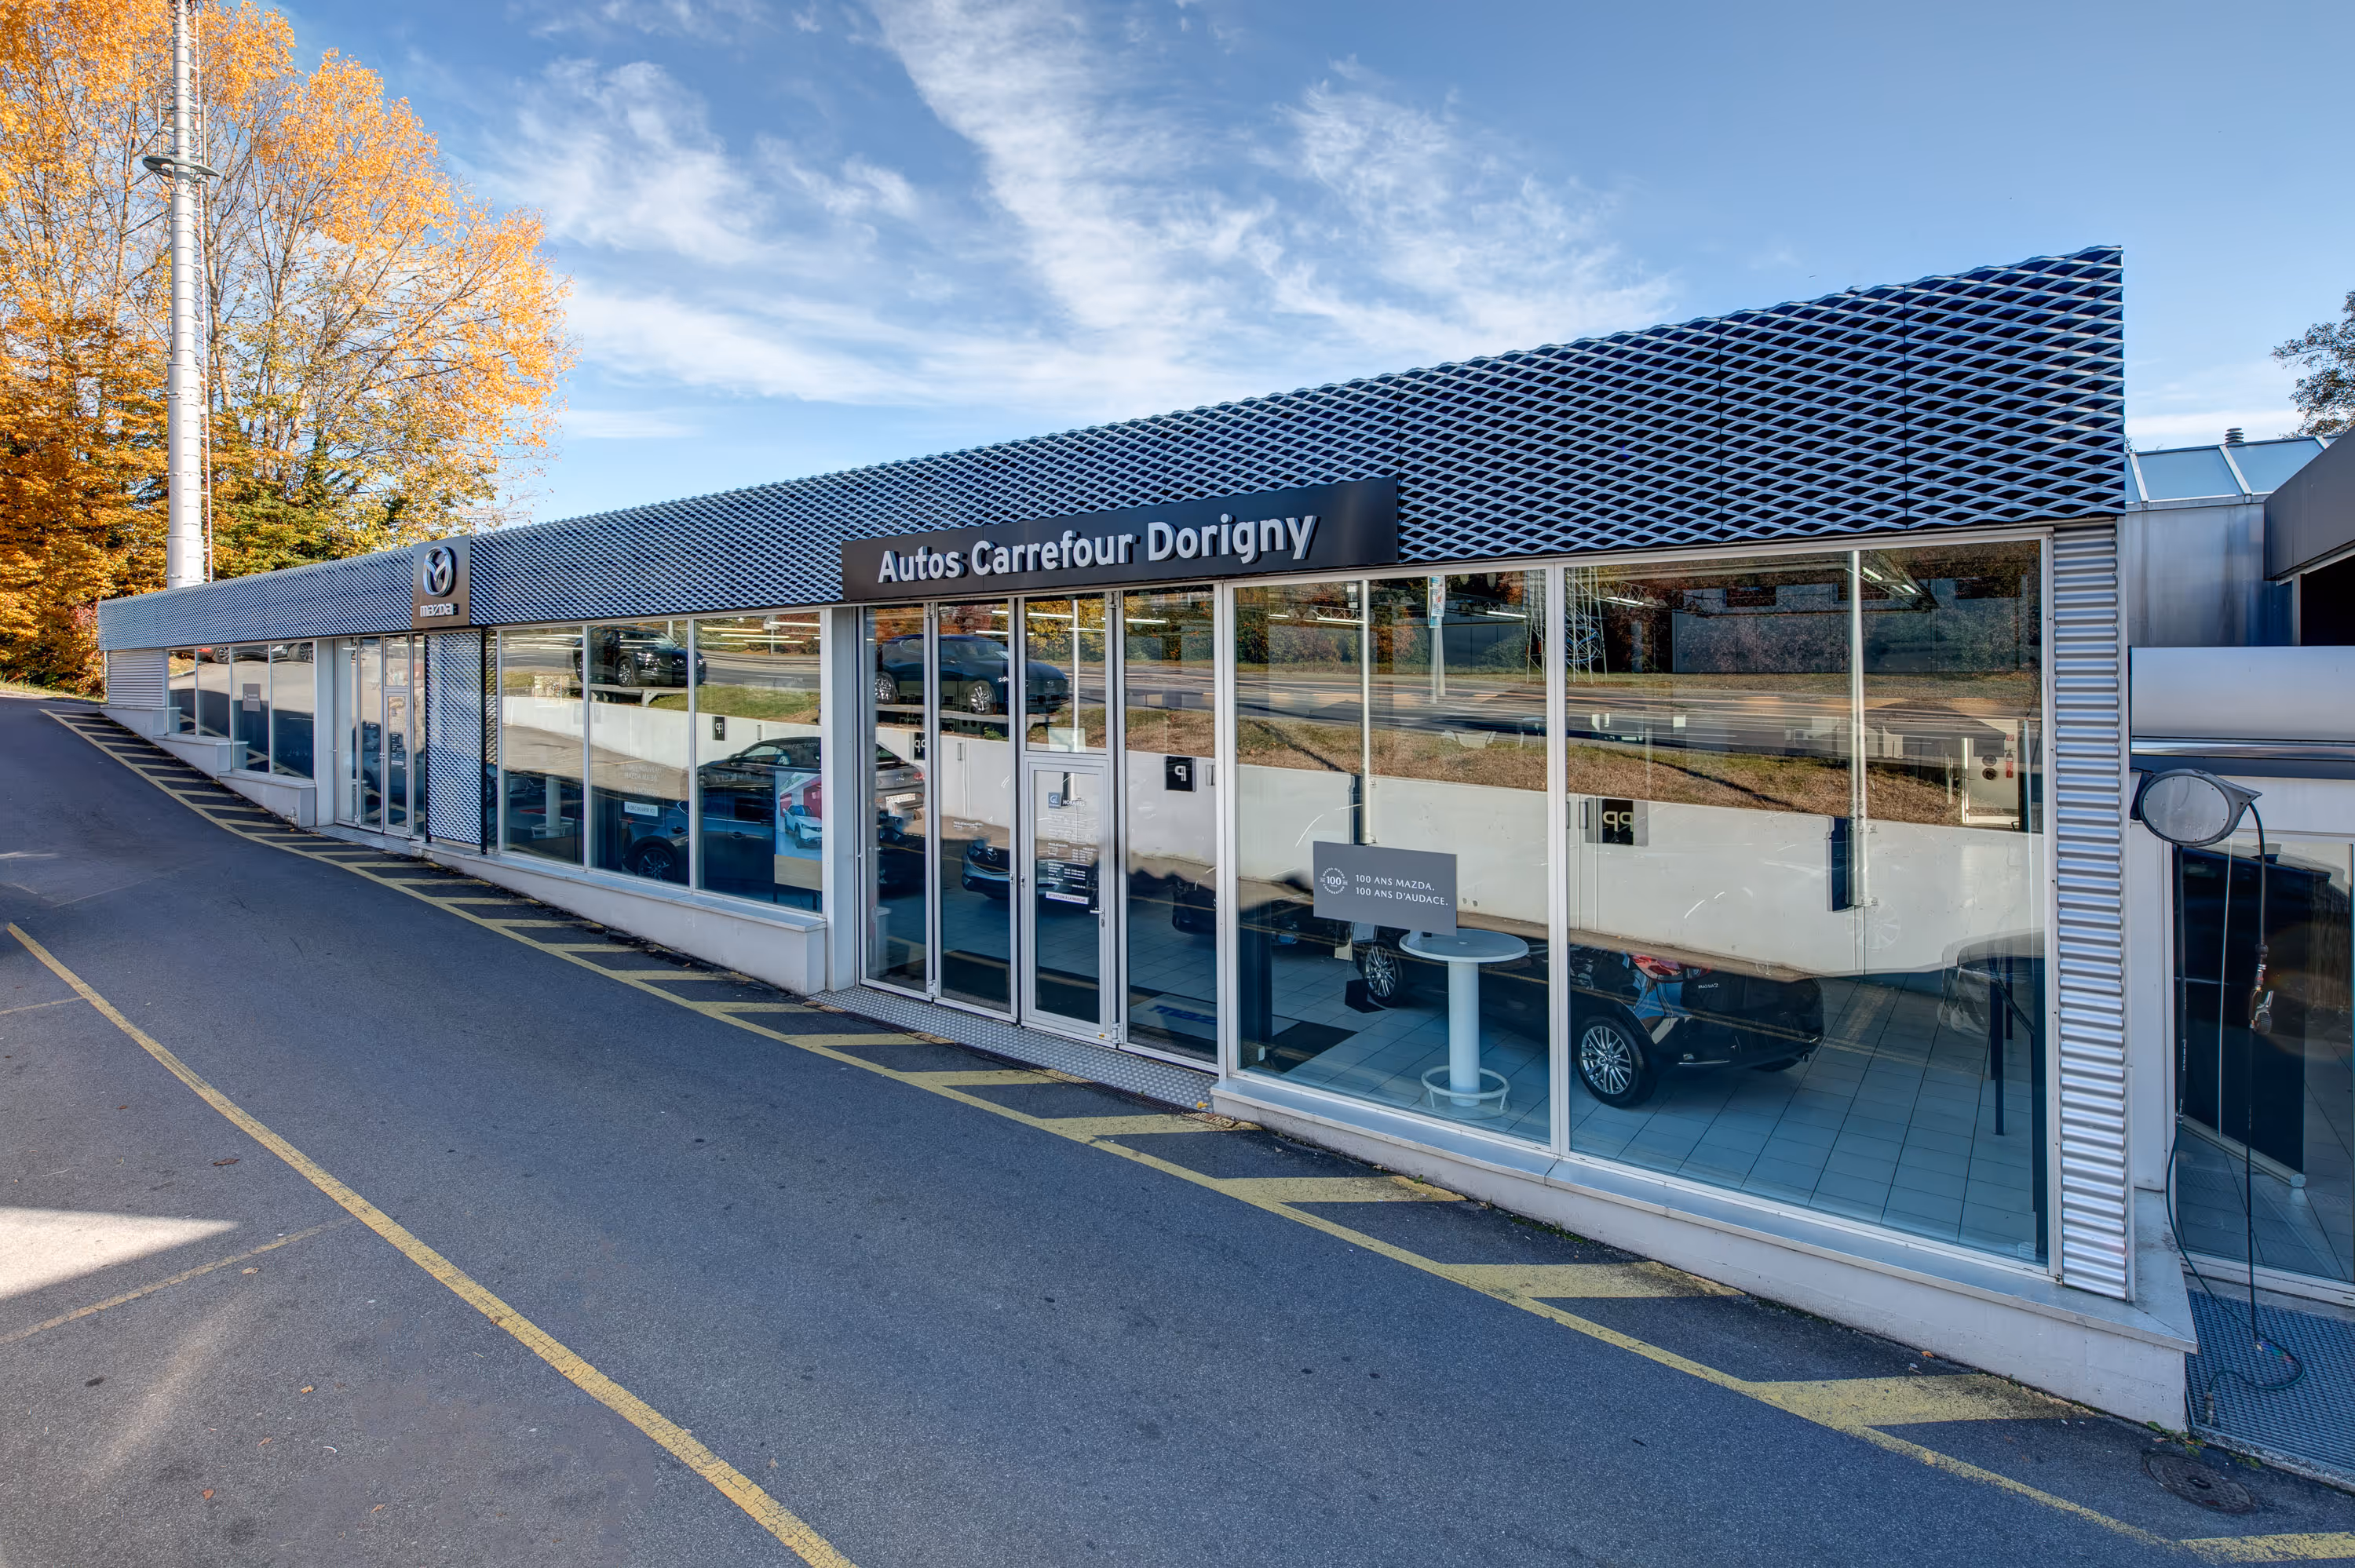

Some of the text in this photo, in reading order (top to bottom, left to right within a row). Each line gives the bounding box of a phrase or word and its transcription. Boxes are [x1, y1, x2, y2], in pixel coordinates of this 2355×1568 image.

[877, 514, 1317, 583] Autos Carrefour Dorigny
[1322, 866, 1334, 877] MAZDA
[1326, 876, 1342, 885] 100
[1356, 874, 1371, 884] 100
[1374, 877, 1393, 886] ANS
[1395, 879, 1435, 892] MAZDA.
[1356, 887, 1448, 906] 100 ANS D'AUDACE.
